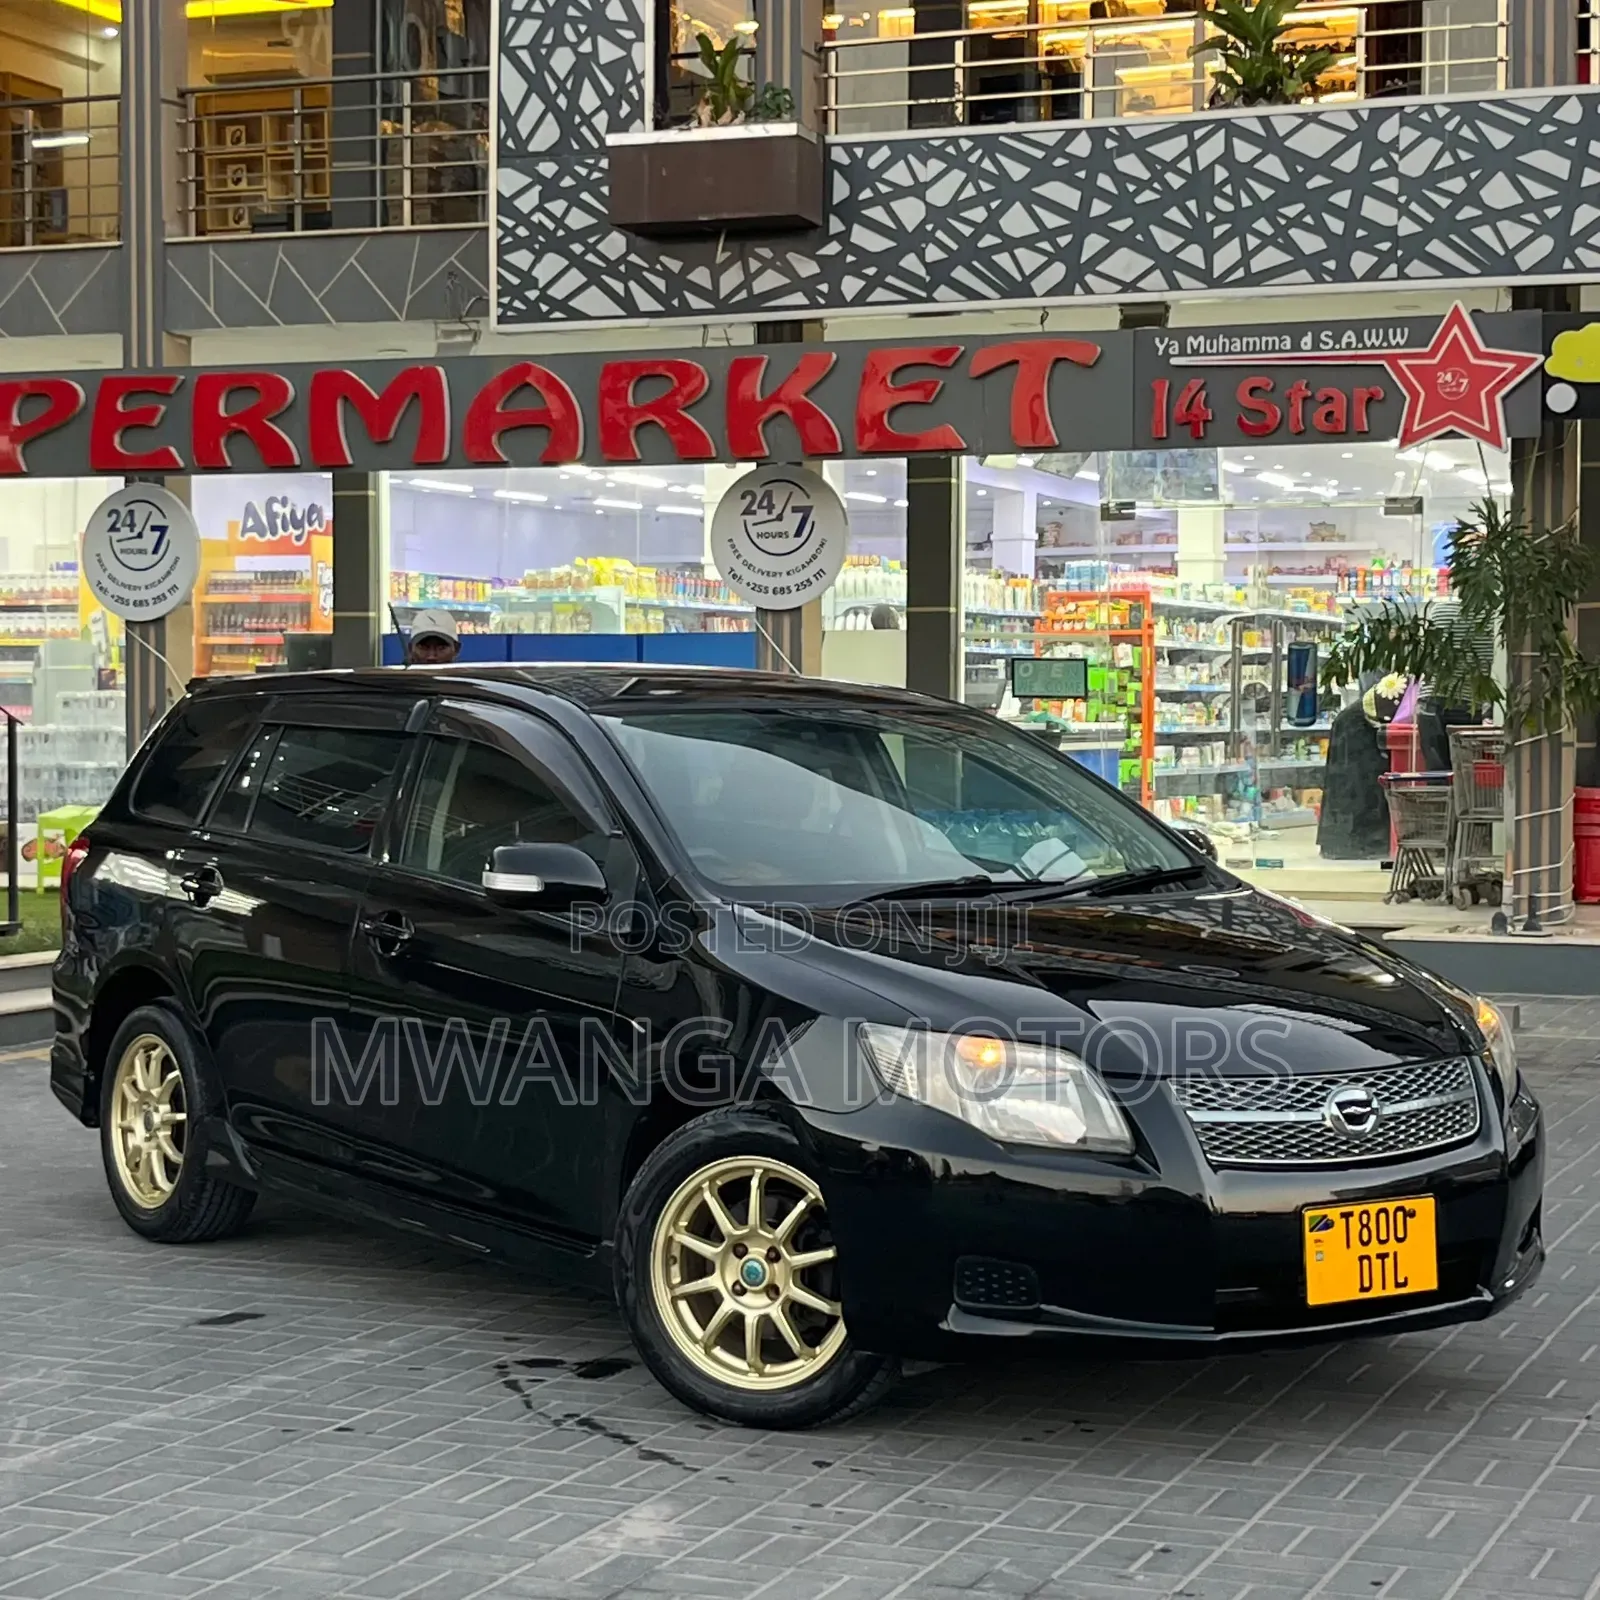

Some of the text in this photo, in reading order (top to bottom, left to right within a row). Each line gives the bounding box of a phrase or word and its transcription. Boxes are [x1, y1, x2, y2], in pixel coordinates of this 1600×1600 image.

[1154, 336, 1179, 356] Ya
[1186, 333, 1292, 354] Muhamma
[1319, 327, 1409, 350] S.A.W.W
[0, 339, 1100, 474] PERMARKET
[1151, 376, 1385, 439] 14 Star
[240, 495, 325, 543] Afiya
[756, 531, 789, 540] HOURS
[120, 548, 148, 556] HOURS
[727, 538, 828, 578] FREE DELIVERY KIGAMBONI
[107, 573, 142, 591] DELIVERY
[727, 566, 744, 584] Tel:
[746, 581, 770, 595] +255
[772, 584, 793, 596] 685
[812, 568, 827, 582] 111
[110, 593, 130, 607] +255
[1017, 680, 1082, 693] WECOME
[1340, 1206, 1408, 1250] T800
[1358, 1251, 1409, 1293] DTL
